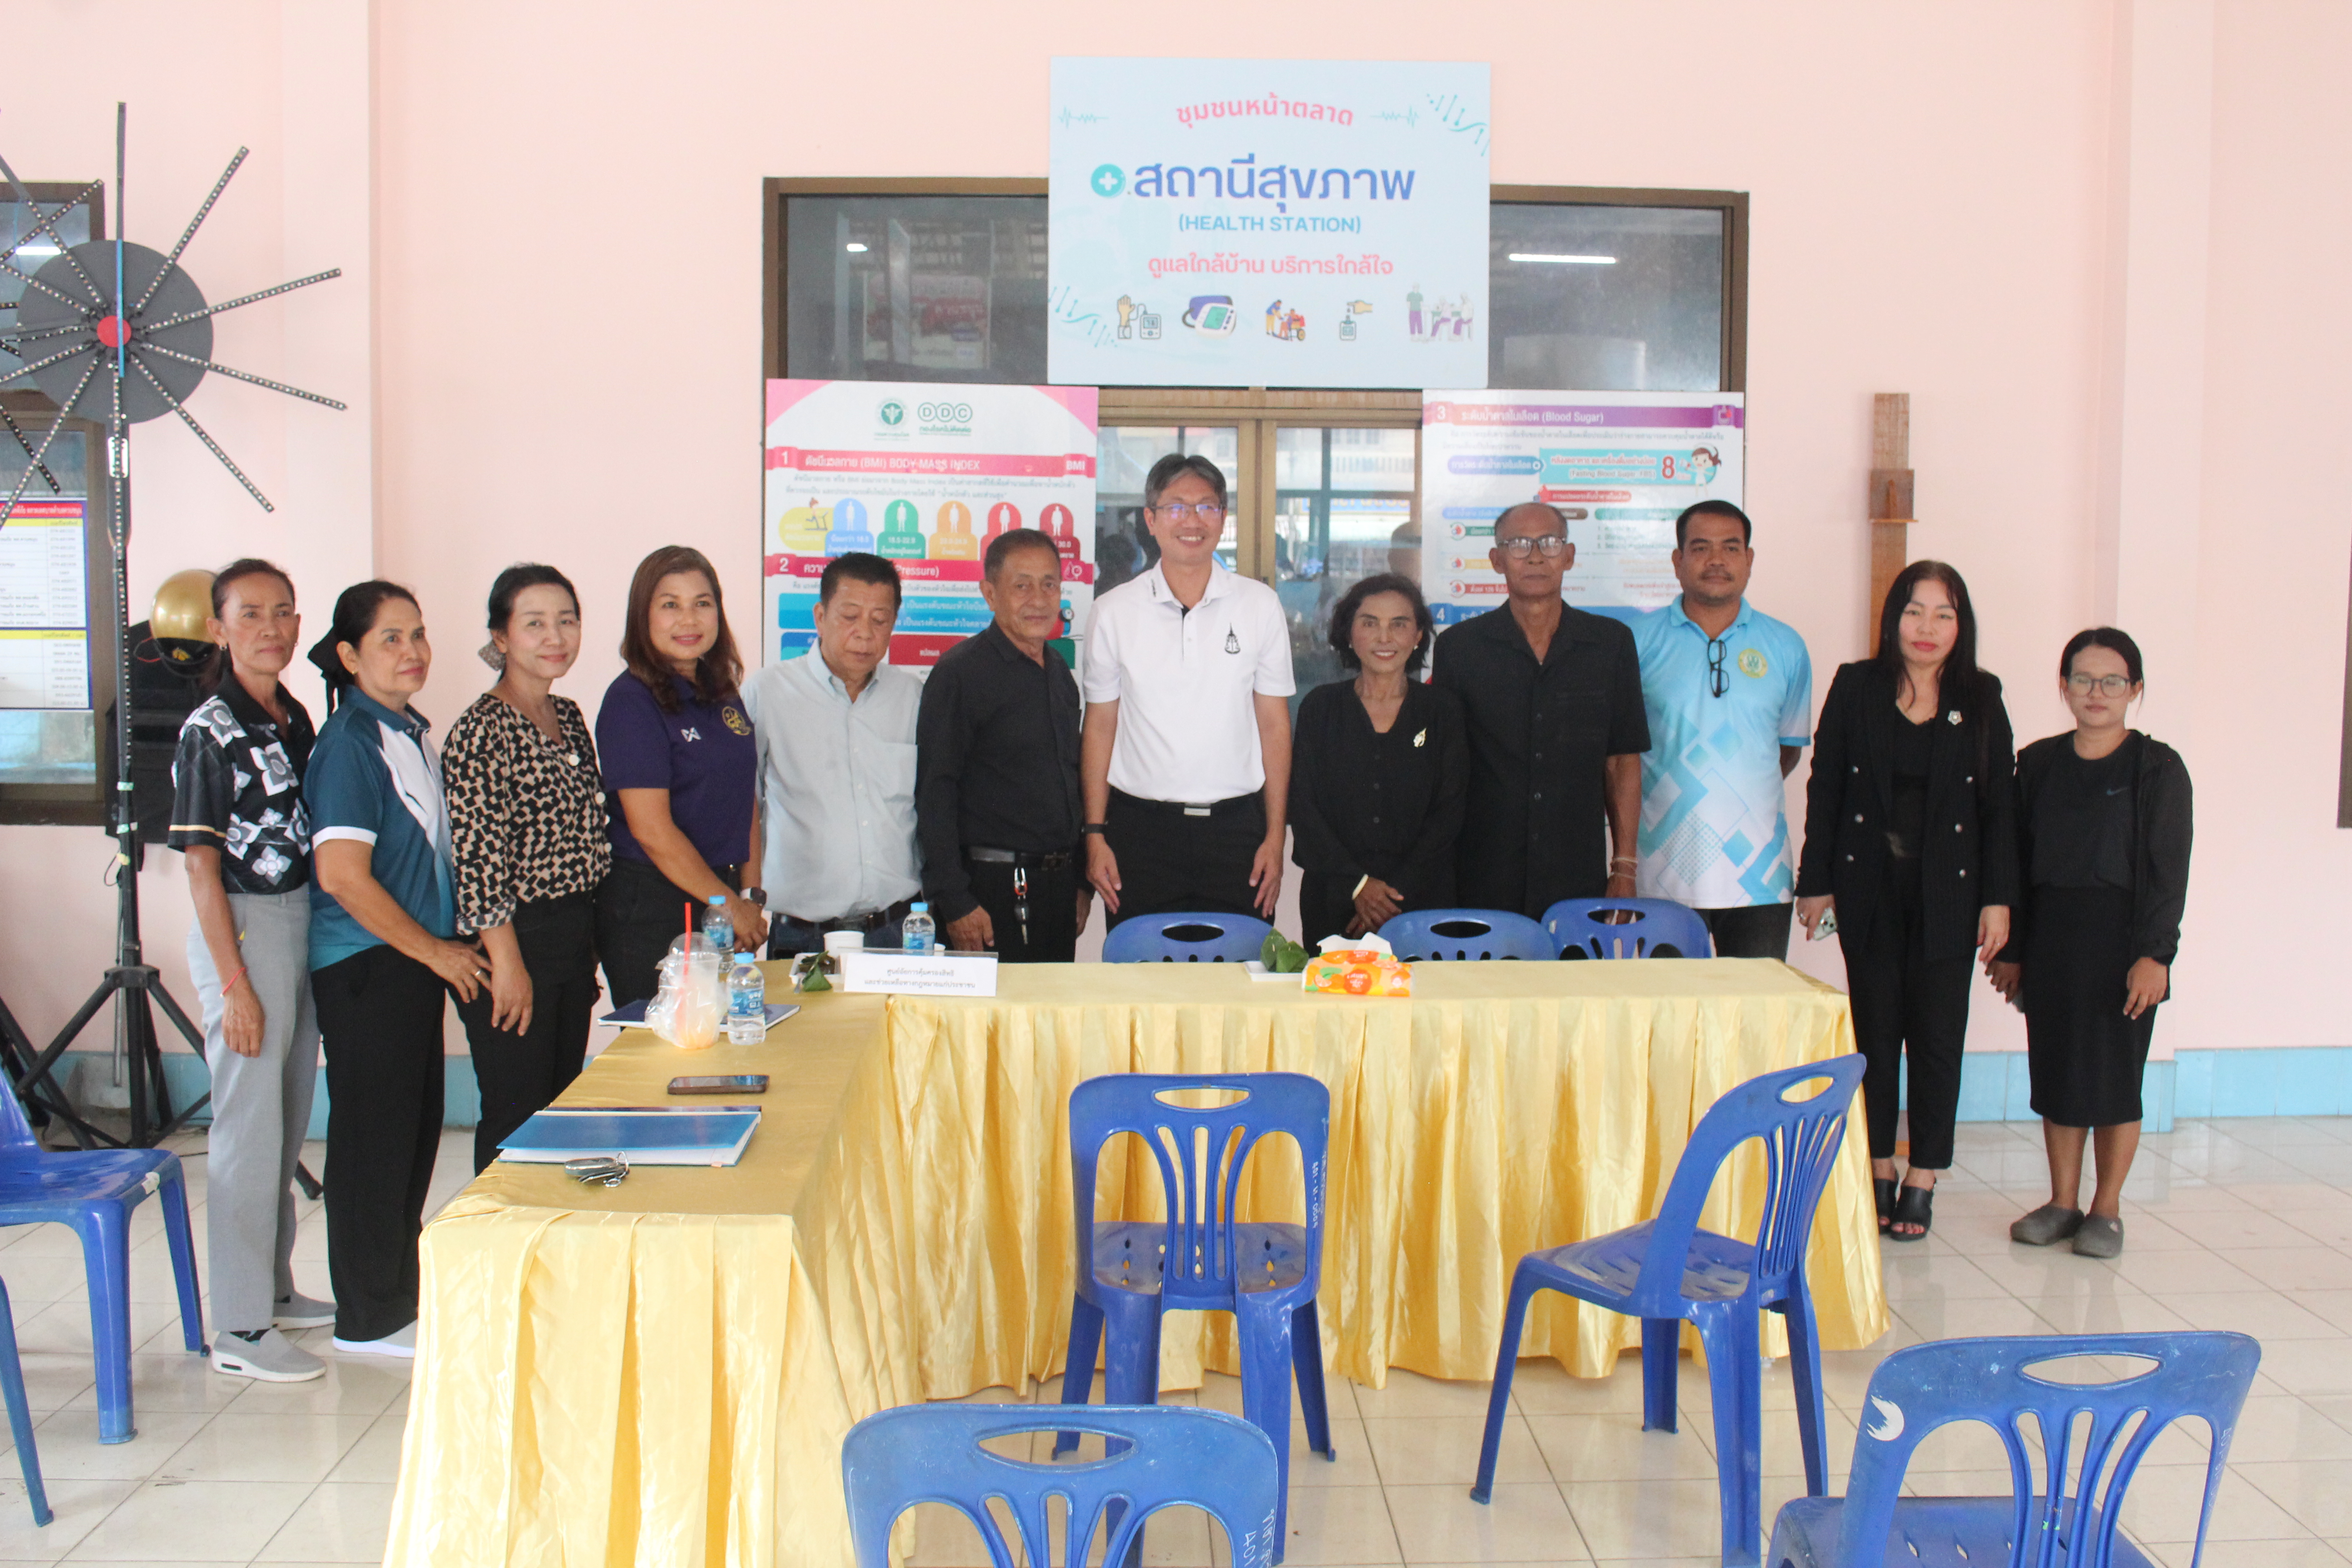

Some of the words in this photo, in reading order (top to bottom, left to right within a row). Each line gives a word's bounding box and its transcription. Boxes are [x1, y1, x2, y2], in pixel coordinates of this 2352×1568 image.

[1176, 92, 1353, 128] ชุมชนหน้าตลาด
[1134, 153, 1415, 214] สถานีสุขภาพ
[1179, 214, 1264, 233] (HEALTH
[1270, 216, 1361, 234] STATION)
[1148, 252, 1265, 278] ดูแลใกล้บ้าน
[1271, 254, 1393, 276] บริการใกล้ใจ
[1437, 406, 1446, 420] 3
[1542, 411, 1571, 424] (Blood
[1574, 411, 1604, 425] Sugar)
[782, 451, 789, 465] 1
[860, 457, 887, 469] (BMI)
[889, 458, 916, 469] BODY
[919, 459, 947, 470] MASS
[950, 460, 980, 470] INDEX
[1067, 460, 1086, 471] BMI
[1661, 455, 1675, 480] 8
[779, 557, 789, 572] 2
[1436, 608, 1445, 621] 4
[1243, 1530, 1257, 1567] 401
